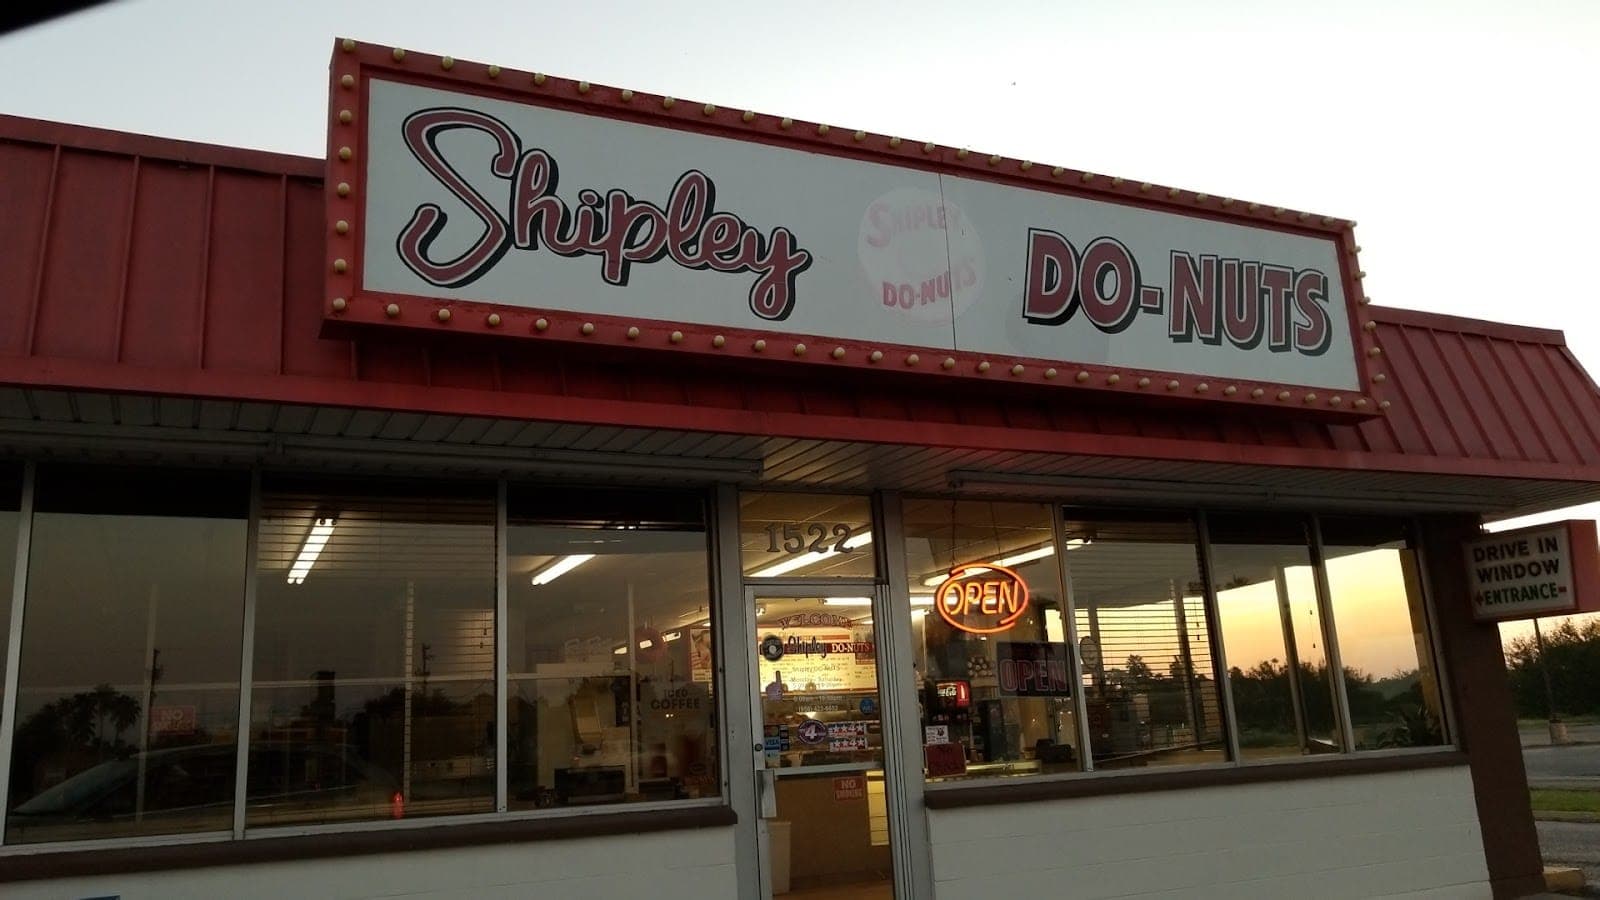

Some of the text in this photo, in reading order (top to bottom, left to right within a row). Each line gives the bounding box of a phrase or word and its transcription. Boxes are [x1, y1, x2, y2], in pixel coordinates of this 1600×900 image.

[397, 107, 812, 321] Shipley
[1022, 227, 1333, 357] DO-NUTS
[765, 522, 854, 554] 1522
[1473, 536, 1559, 563] DRIVE IN
[1476, 558, 1560, 583] WINDOW
[943, 581, 1019, 615] OPEN
[1484, 582, 1559, 606] ENTRANCE
[831, 642, 871, 654] DO-NUTS
[1000, 659, 1068, 693] OPEN
[651, 700, 701, 711] COFFEE
